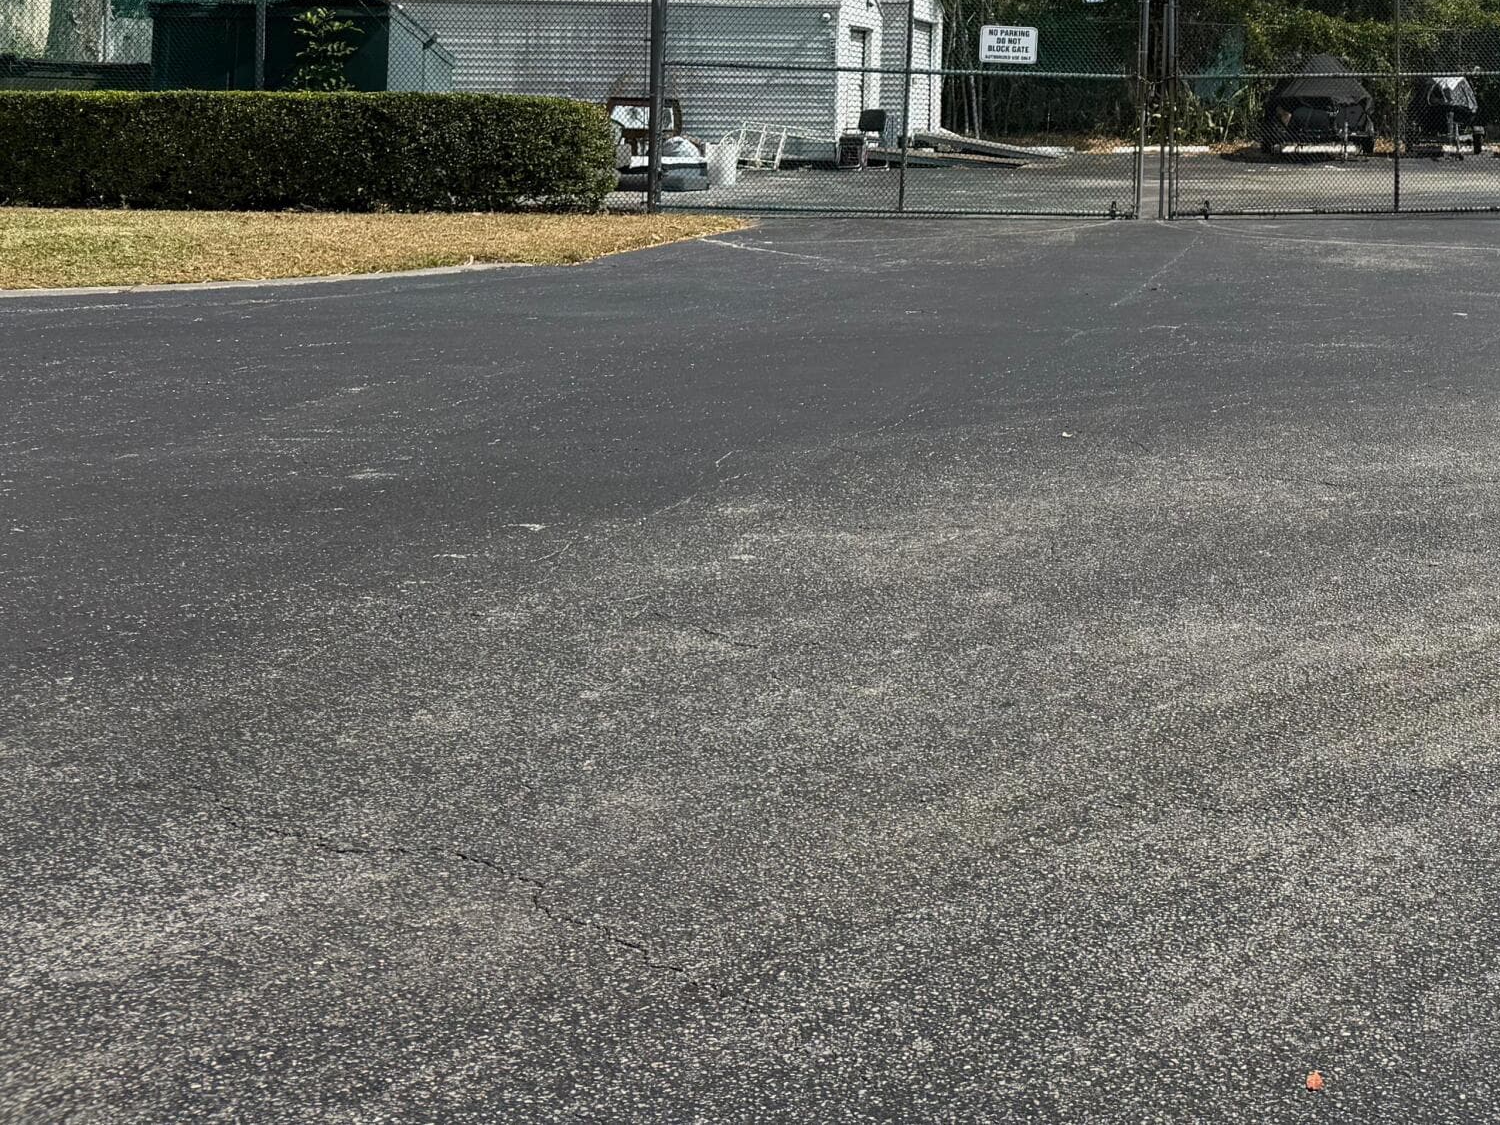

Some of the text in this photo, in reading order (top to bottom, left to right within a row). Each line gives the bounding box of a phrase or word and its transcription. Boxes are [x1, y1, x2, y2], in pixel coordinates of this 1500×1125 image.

[1000, 29, 1030, 37] PARKING
[1008, 37, 1022, 45] NOT
[987, 44, 1029, 53] BLOCK GATE
